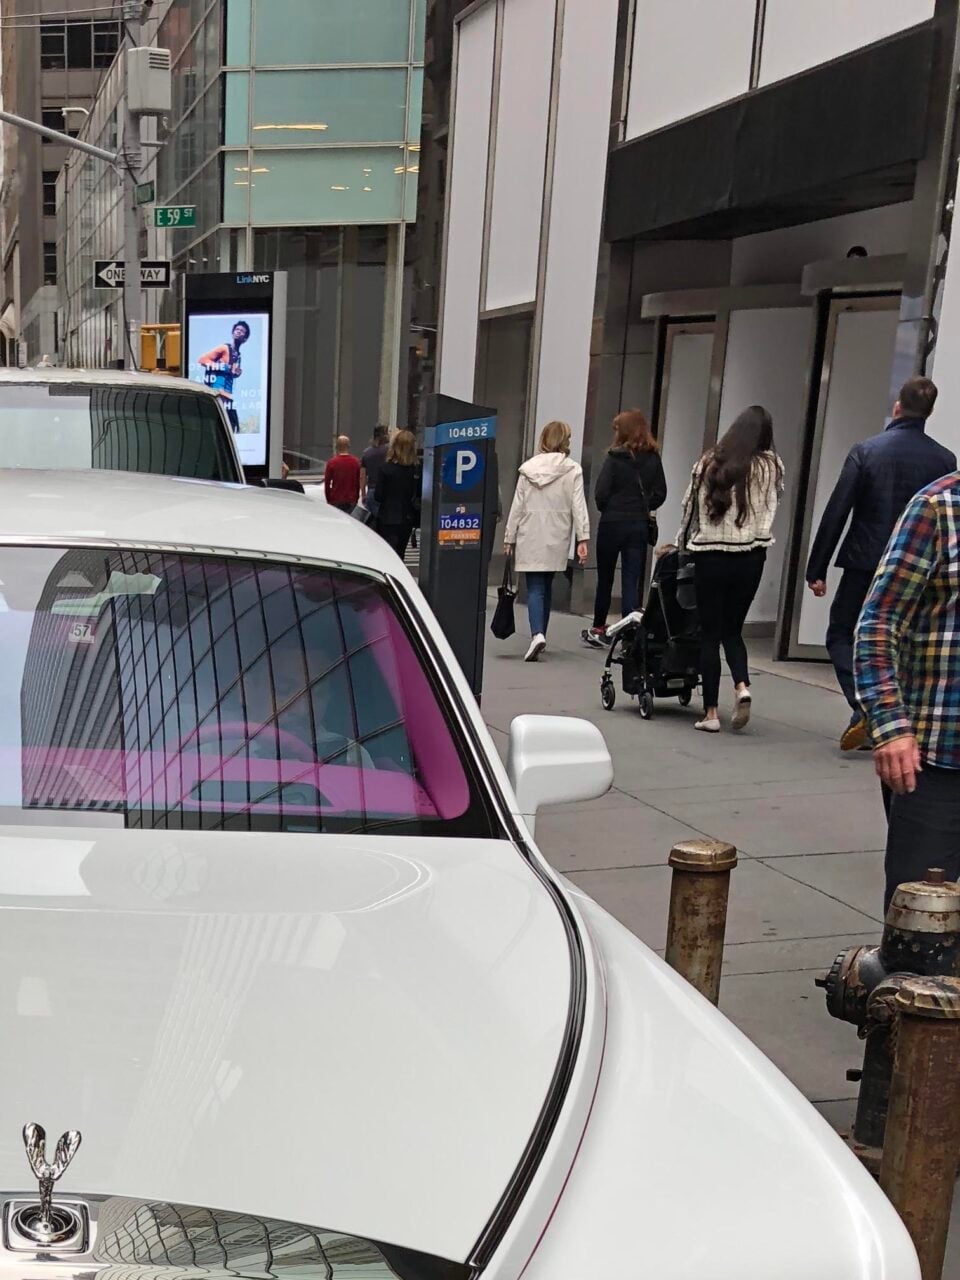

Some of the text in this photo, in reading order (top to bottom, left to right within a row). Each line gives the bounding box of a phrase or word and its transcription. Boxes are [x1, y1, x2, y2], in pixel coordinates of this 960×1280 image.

[157, 209, 193, 225] E 59 ST
[449, 426, 487, 438] 104832
[456, 450, 477, 484] P
[441, 519, 479, 529] 104832
